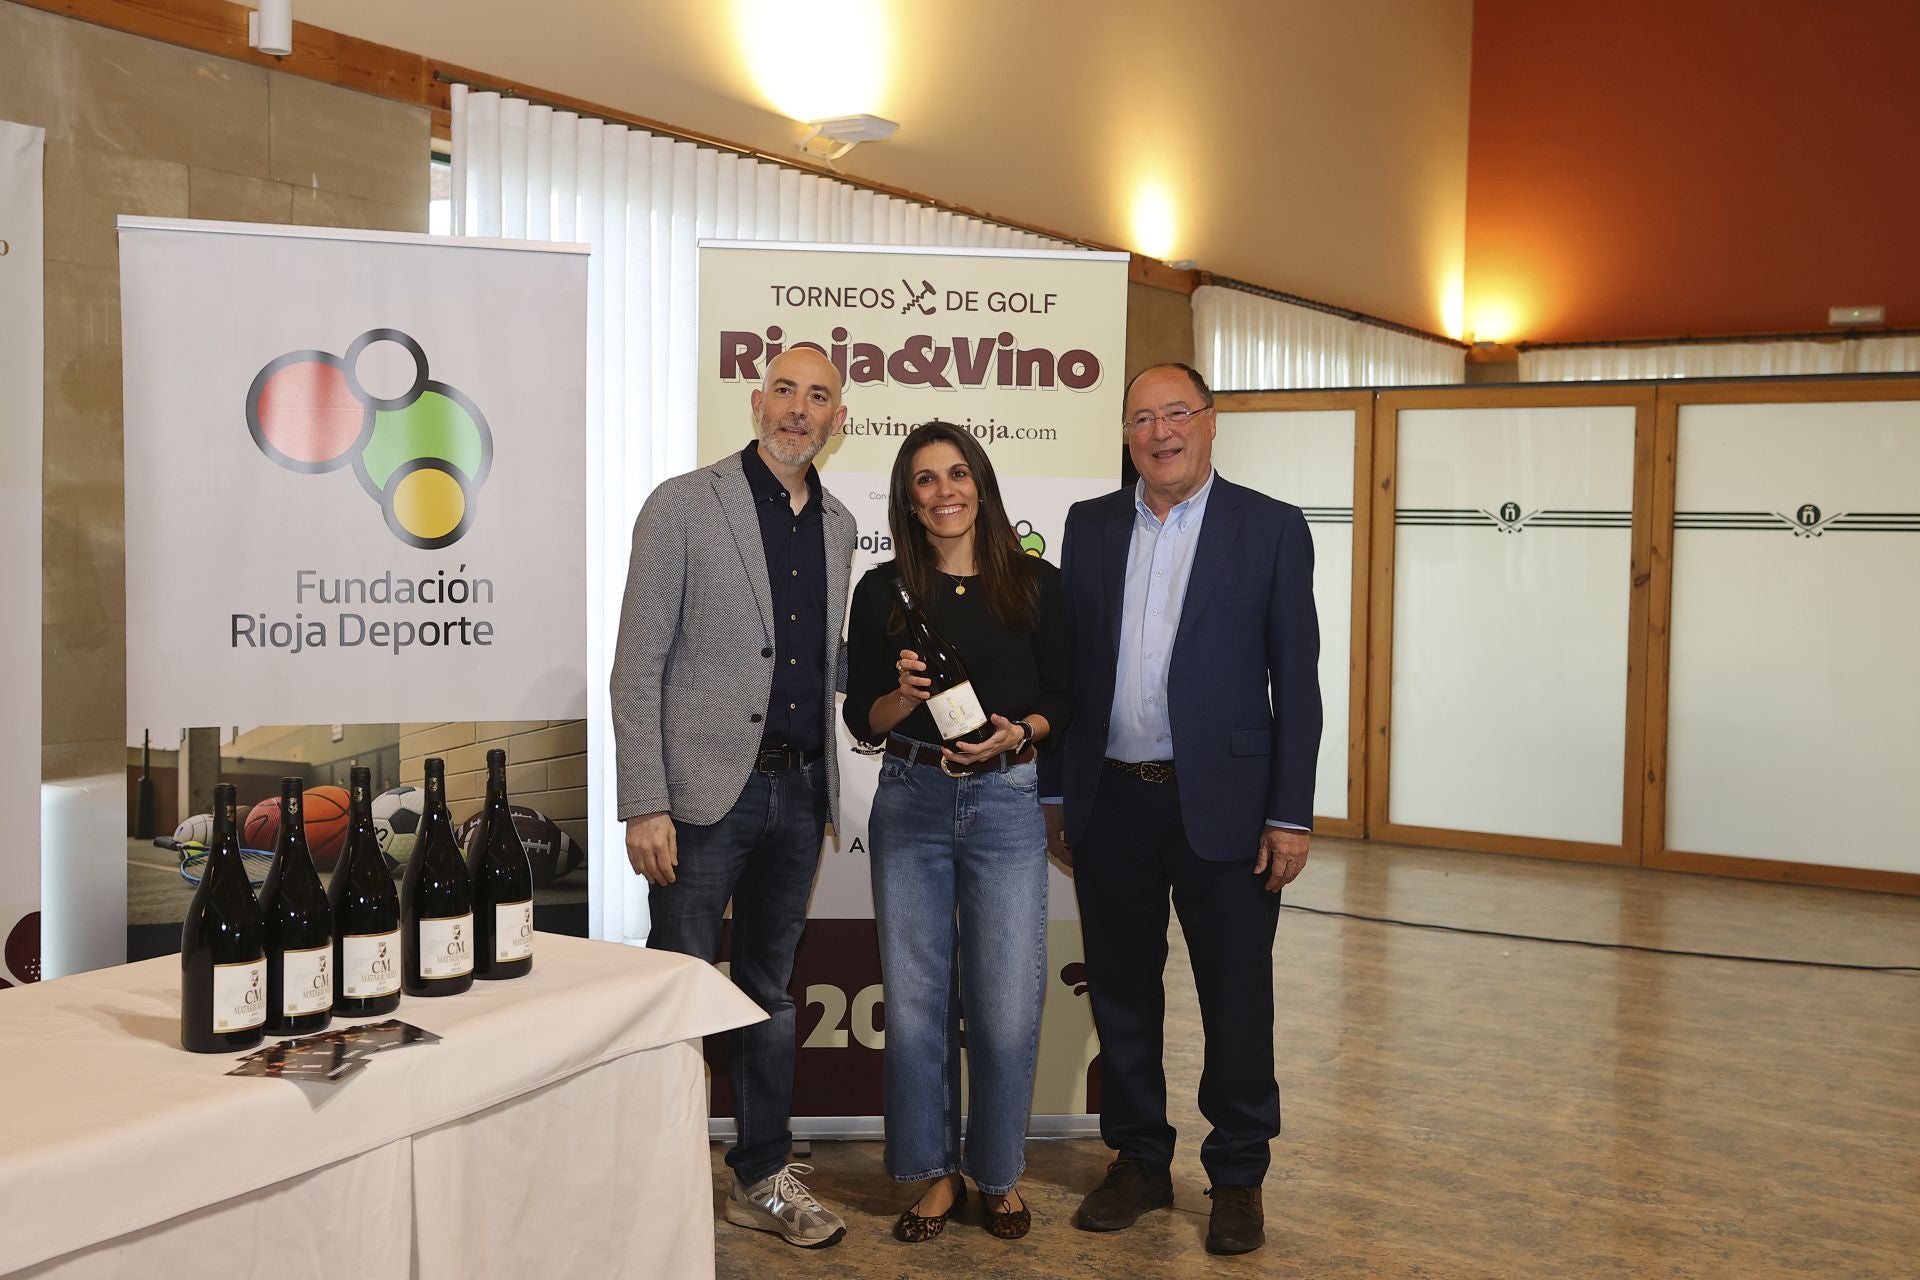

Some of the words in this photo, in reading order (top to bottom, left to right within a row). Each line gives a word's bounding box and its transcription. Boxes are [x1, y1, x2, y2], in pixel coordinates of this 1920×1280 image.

[771, 285, 895, 309] TORNEOS
[946, 290, 978, 312] DE
[987, 292, 1057, 314] GOLF
[719, 325, 1104, 393] Rija&Vino
[869, 491, 887, 500] Con
[854, 530, 892, 554] ioja
[296, 563, 494, 604] Fundación
[231, 613, 327, 654] Rioja
[339, 613, 494, 656] Deporte
[447, 941, 465, 956] CM
[372, 959, 391, 974] CM
[313, 973, 329, 989] CM
[245, 988, 262, 1005] CM
